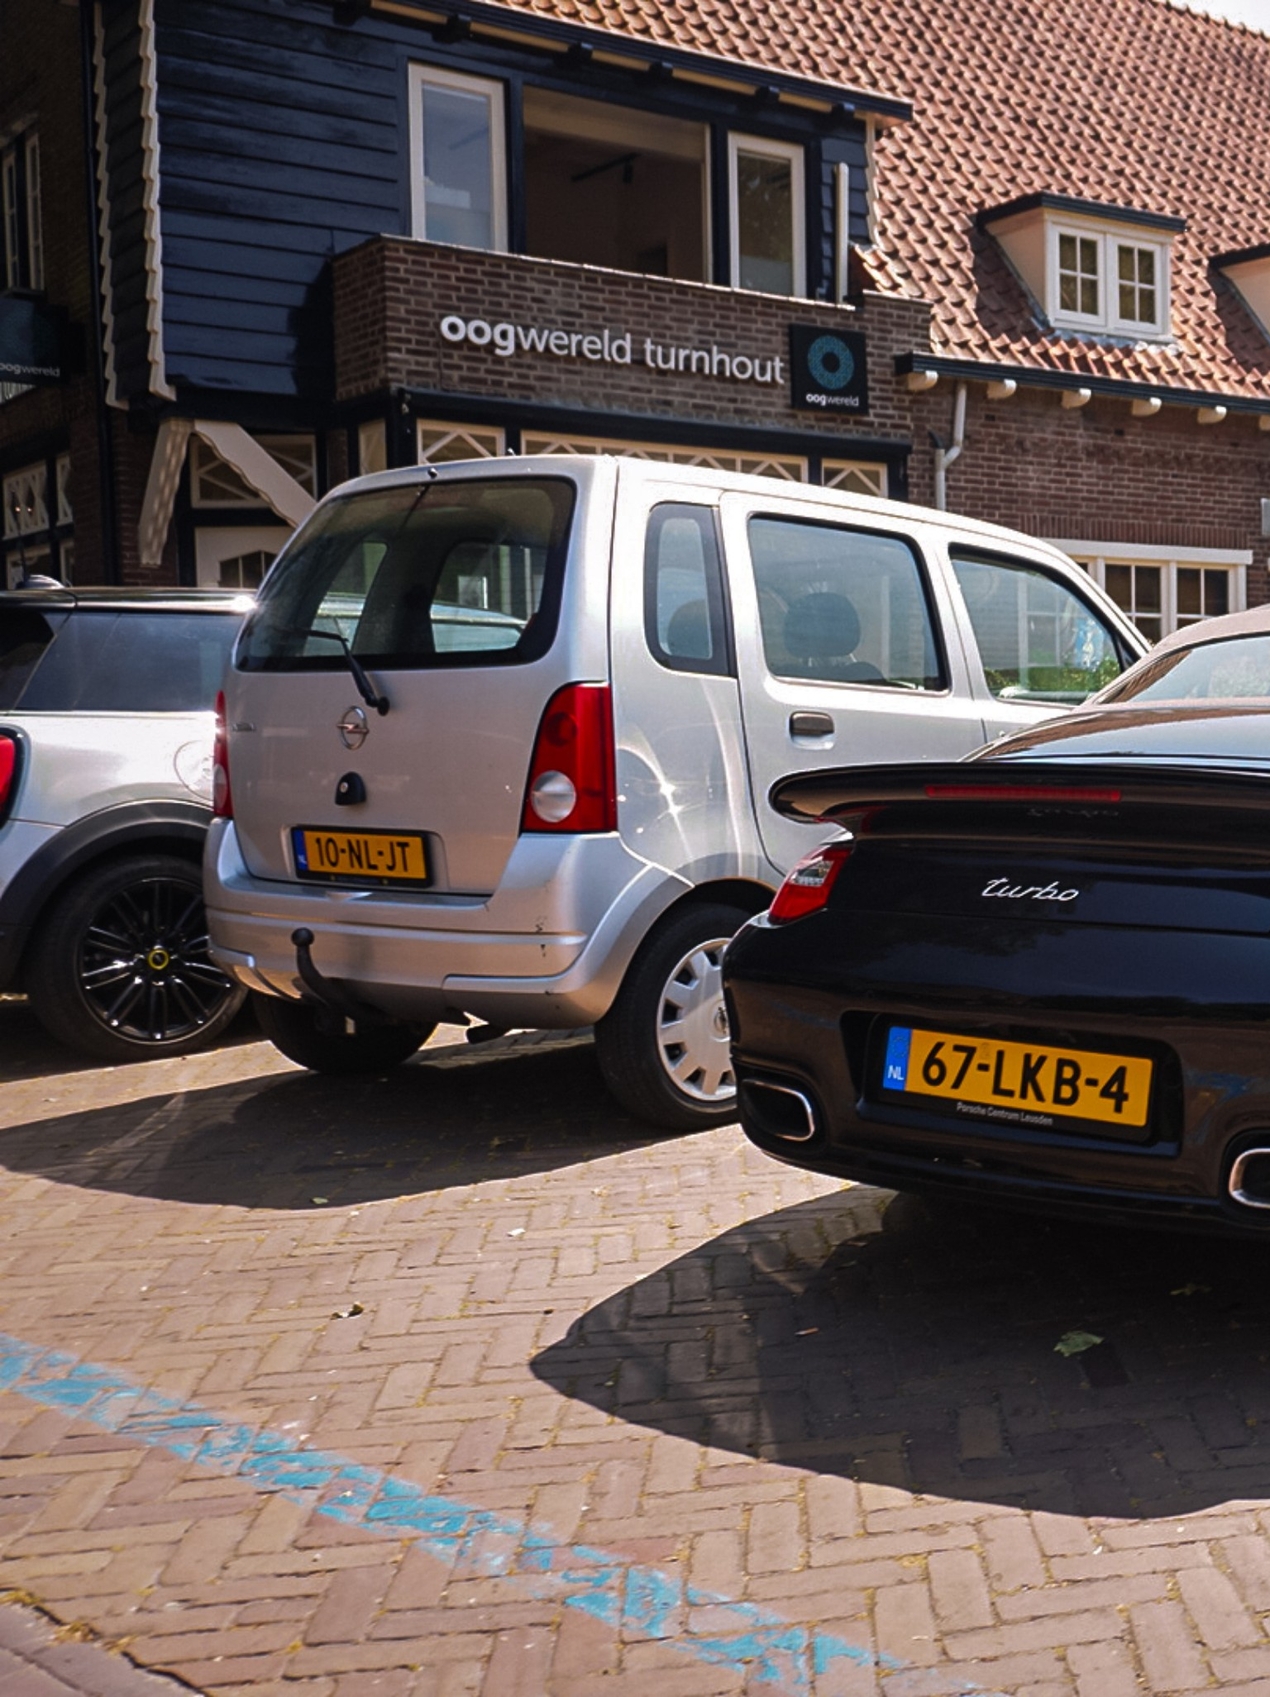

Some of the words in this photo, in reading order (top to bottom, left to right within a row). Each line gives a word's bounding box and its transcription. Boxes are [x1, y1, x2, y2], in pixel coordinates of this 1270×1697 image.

[440, 315, 632, 364] oogwereld
[644, 338, 784, 384] turnhout
[806, 393, 859, 407] oogwereld
[315, 836, 409, 872] 10-NL-JT
[981, 877, 1079, 901] turbo
[887, 1064, 904, 1081] NL
[921, 1041, 1129, 1114] 67-LKB-4
[956, 1101, 986, 1115] Porsche
[987, 1106, 1019, 1120] Centrum
